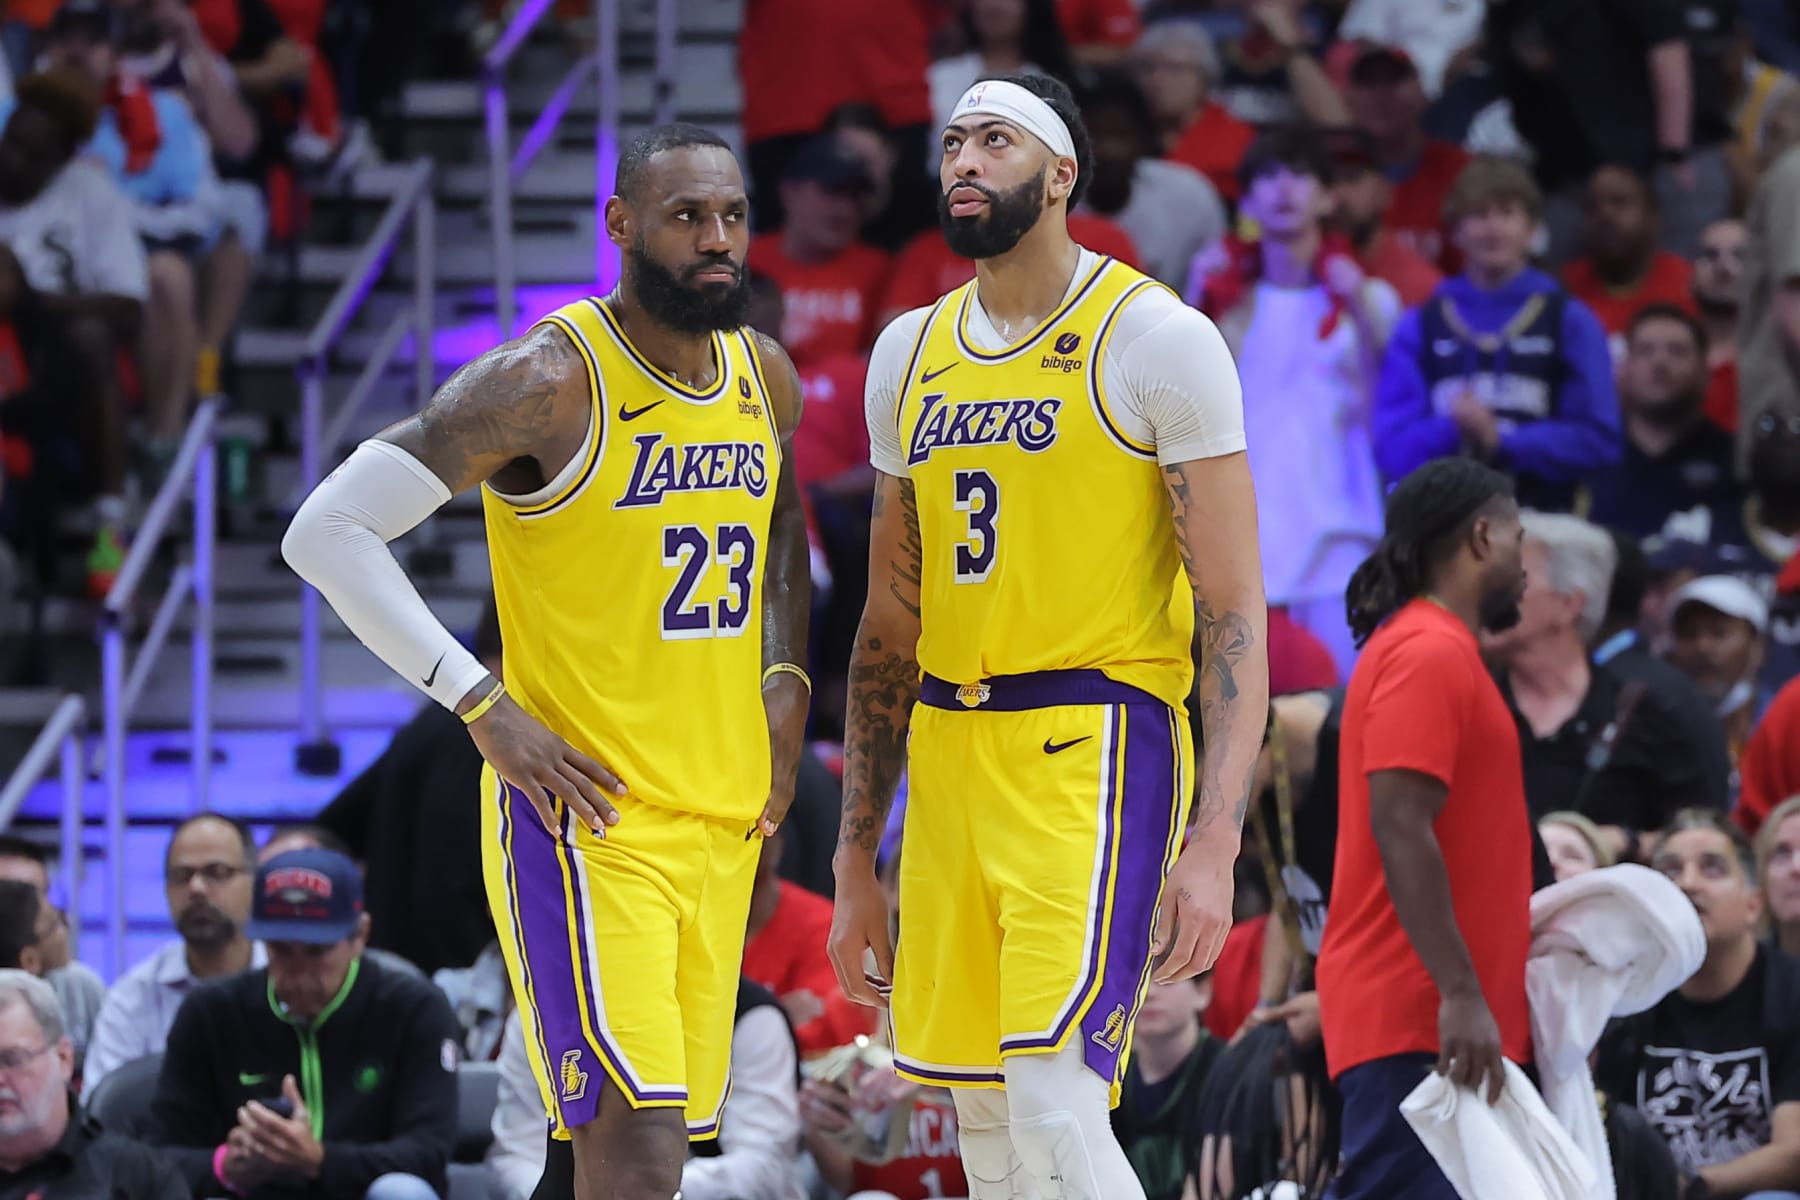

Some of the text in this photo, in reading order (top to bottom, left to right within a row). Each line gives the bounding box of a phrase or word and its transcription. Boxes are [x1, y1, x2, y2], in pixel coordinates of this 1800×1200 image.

[1041, 356, 1082, 373] bibigo
[738, 400, 762, 419] bibigo
[907, 391, 1063, 468] LAKERS
[611, 431, 768, 510] LAKERS
[953, 468, 1001, 585] 3
[660, 522, 756, 641] 23
